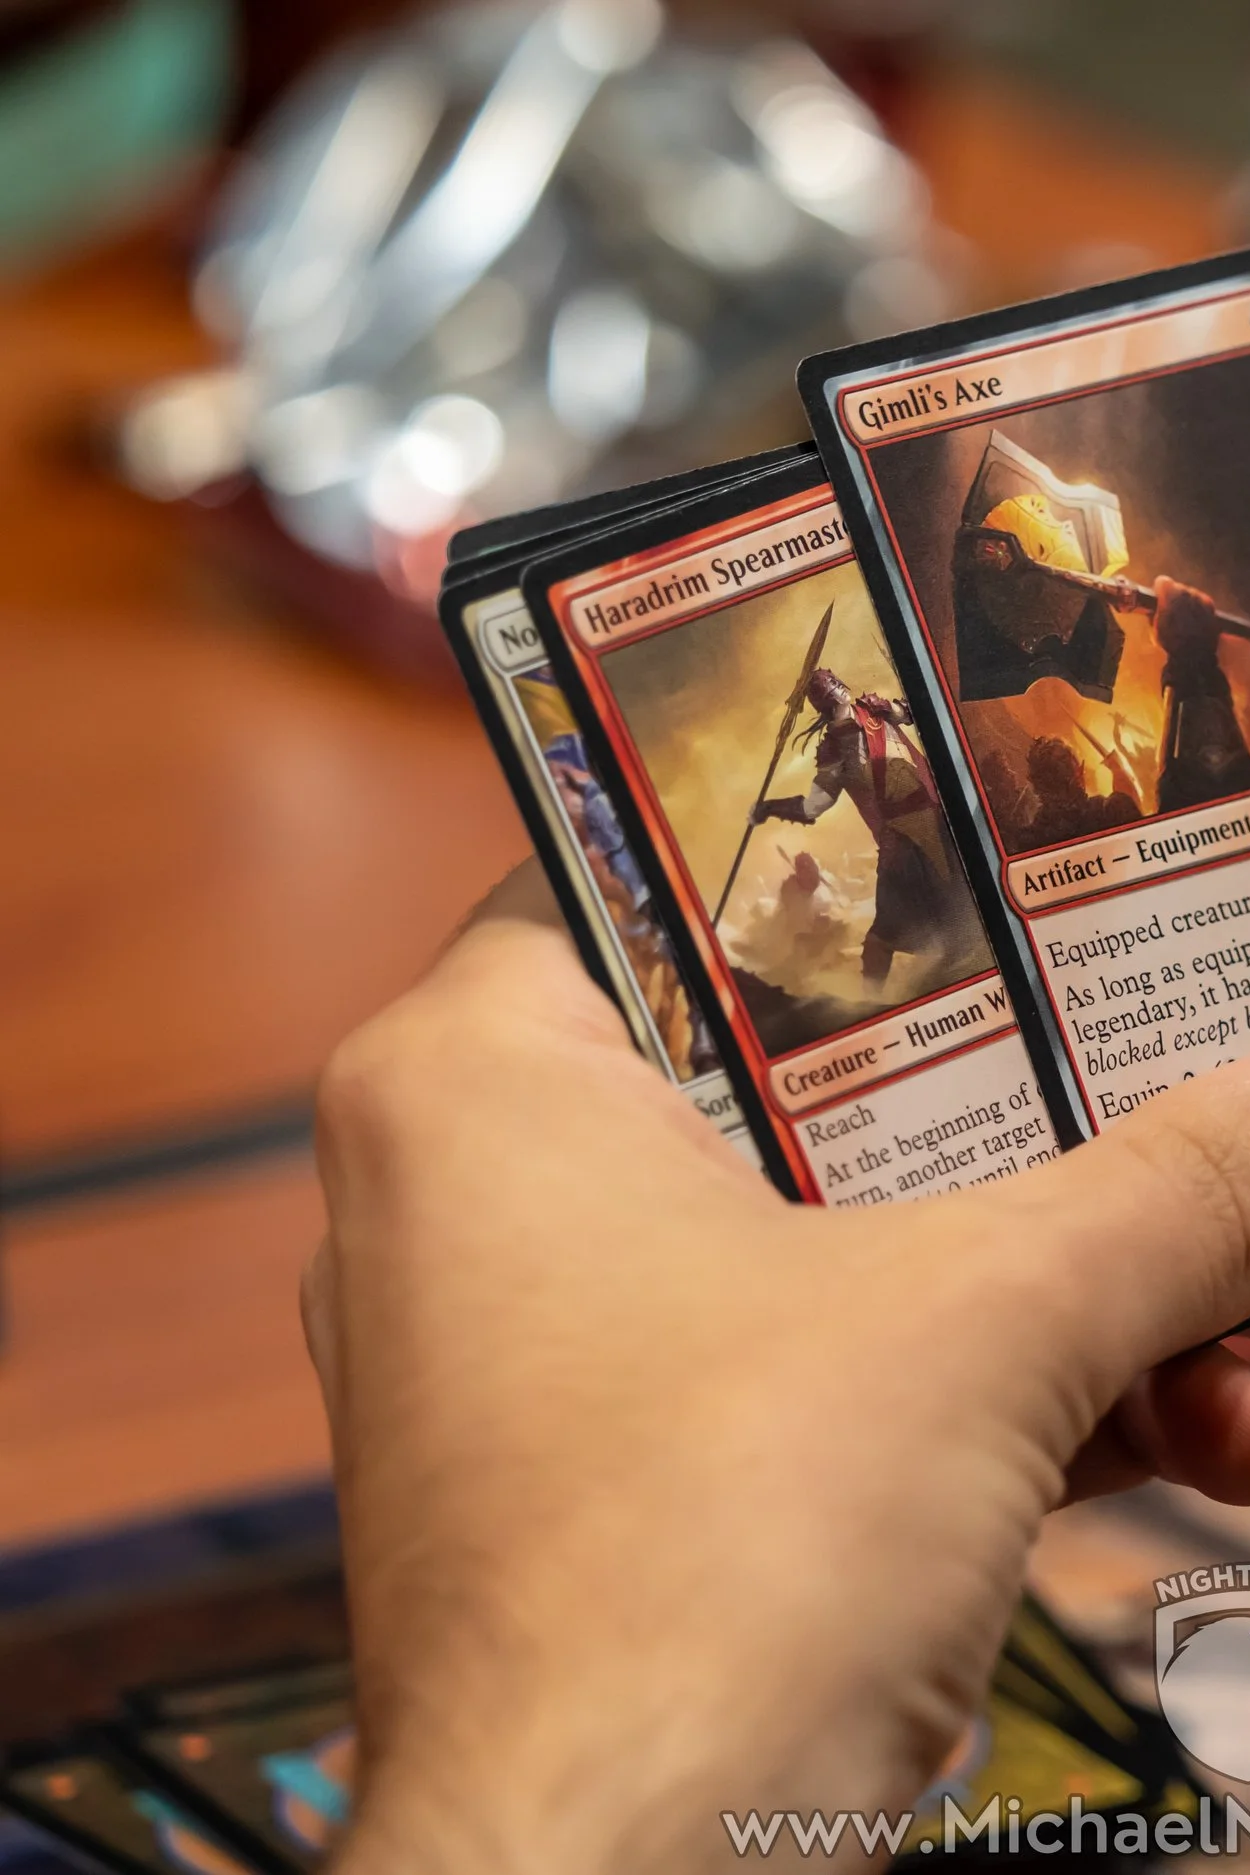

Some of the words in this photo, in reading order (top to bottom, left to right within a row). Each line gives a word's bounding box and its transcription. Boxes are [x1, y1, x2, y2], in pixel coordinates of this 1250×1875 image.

[858, 383, 947, 431] Gimli's
[955, 375, 1002, 409] Axe
[583, 572, 711, 635] Haradrim
[1022, 857, 1107, 896] Artifact
[1044, 914, 1164, 969] Equipped
[1064, 984, 1096, 1011] As
[1099, 964, 1155, 1002] long
[1160, 961, 1186, 985] as
[1071, 991, 1199, 1045] legendary,
[1200, 984, 1221, 1009] it
[784, 1045, 878, 1096] Creature
[905, 1003, 986, 1047] Human
[1085, 1032, 1167, 1078] blocked
[1173, 1016, 1239, 1053] except
[804, 1104, 877, 1148] Reach
[824, 1160, 853, 1188] At
[856, 1147, 892, 1174] the
[893, 1098, 1005, 1157] beginning
[1008, 1082, 1031, 1111] of
[896, 1143, 979, 1193] another
[981, 1116, 1046, 1157] target
